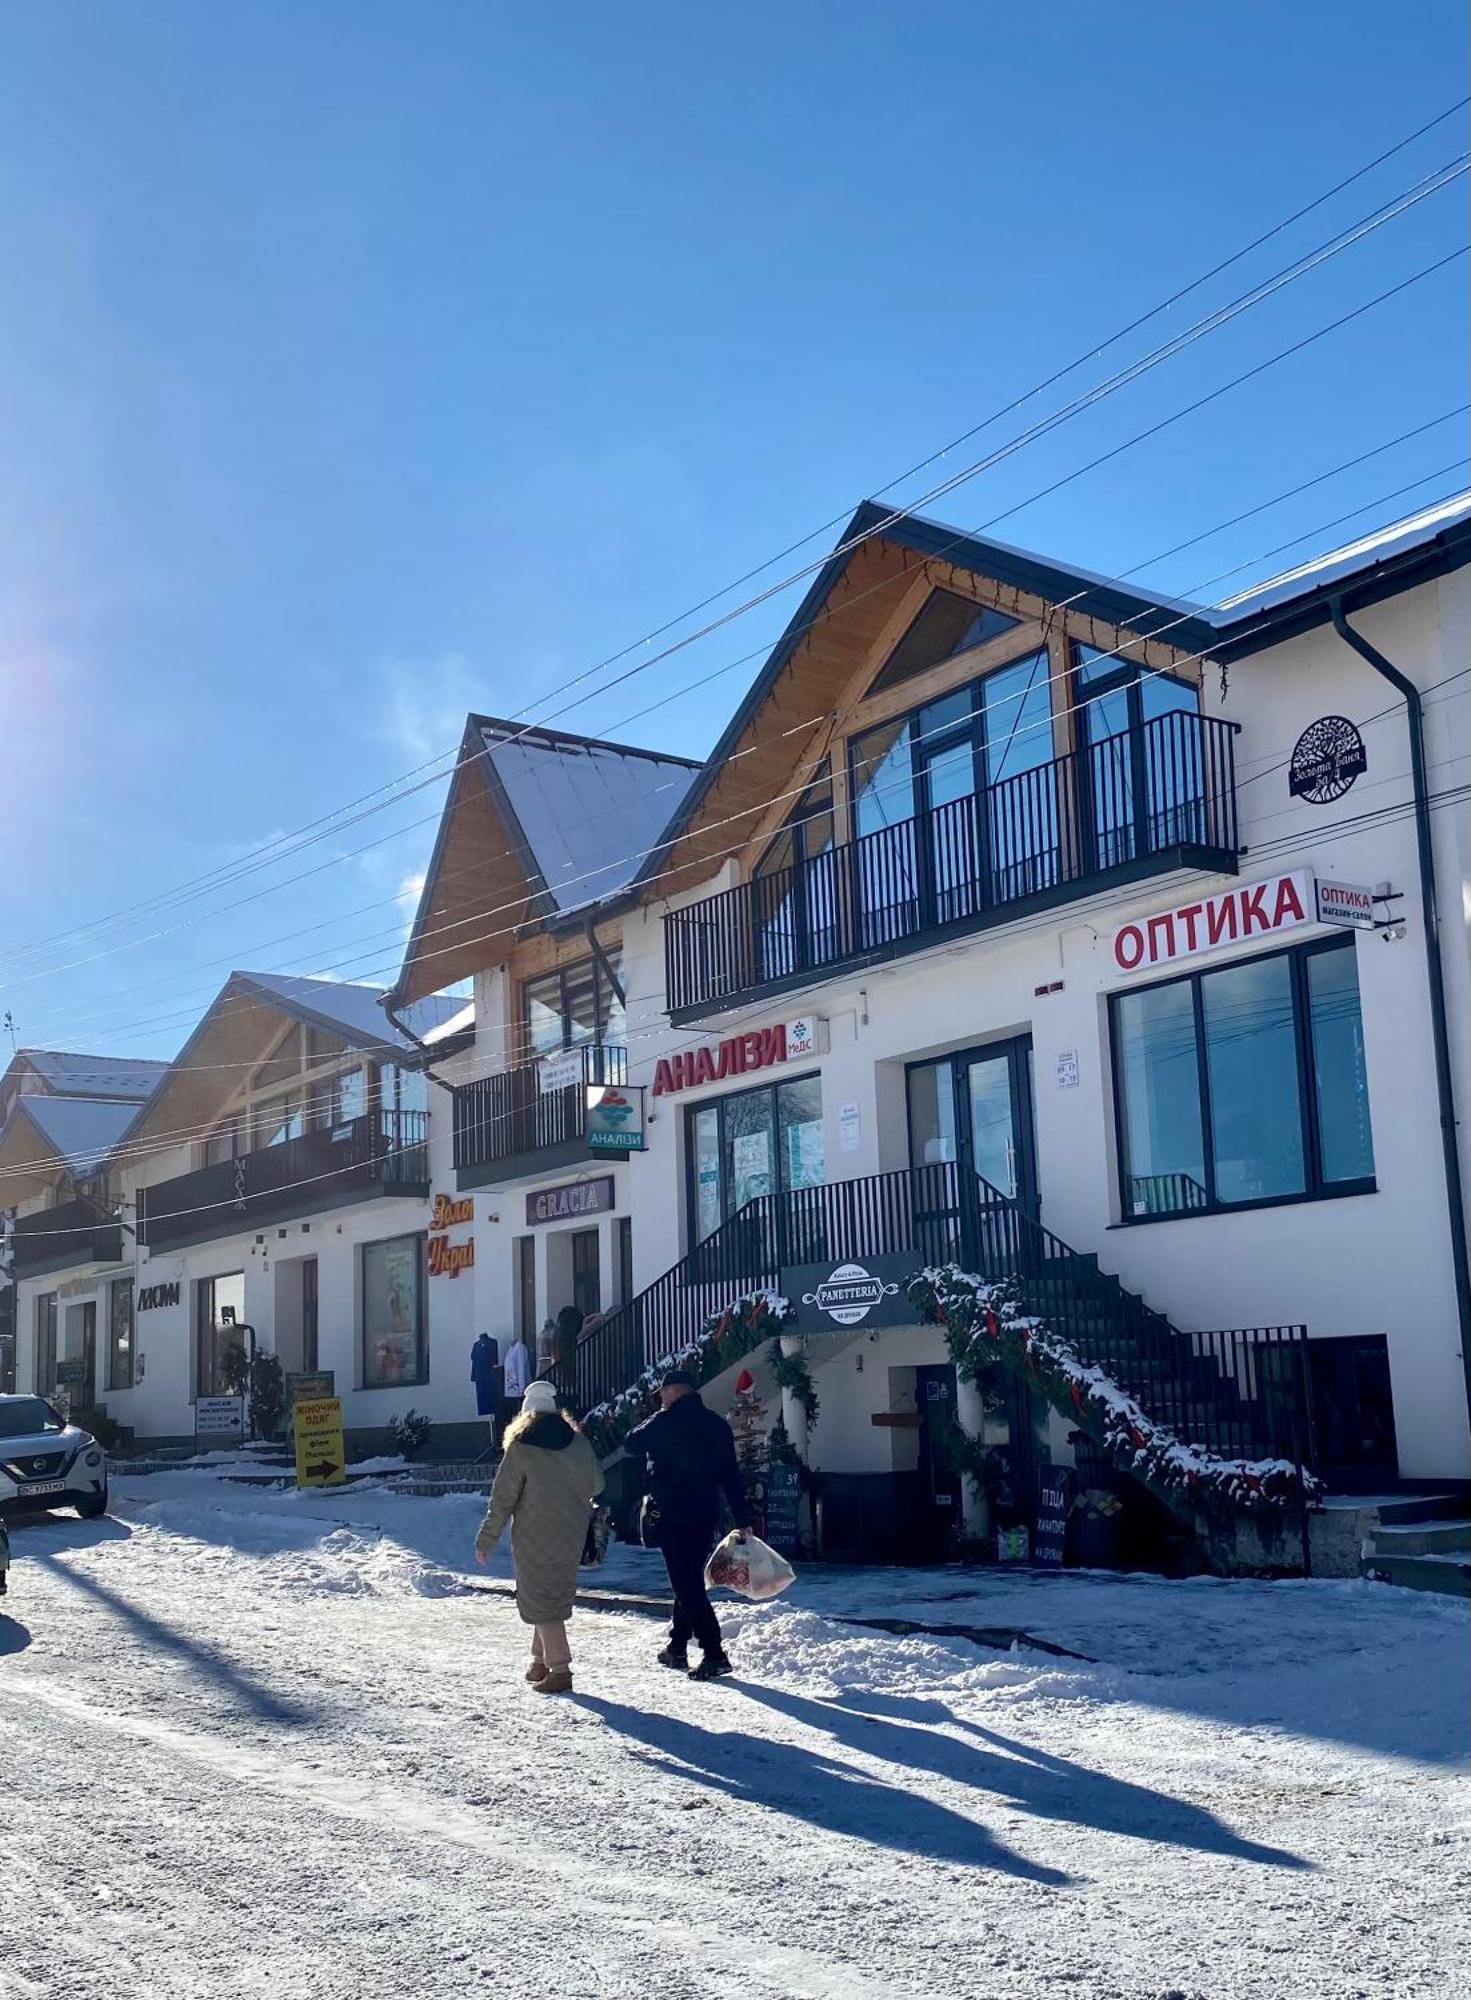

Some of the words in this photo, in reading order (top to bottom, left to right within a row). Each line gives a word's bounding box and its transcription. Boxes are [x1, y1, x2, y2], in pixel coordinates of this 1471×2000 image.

[1321, 887, 1370, 909] ОПТИКА
[1114, 876, 1305, 970] ОПТИКА
[1322, 906, 1372, 921] магазин-салон
[652, 1024, 787, 1096] АНАЛІЗИ
[591, 1132, 642, 1146] АНАЛІЗИ
[535, 1183, 599, 1219] GRACIA
[821, 1284, 877, 1302] PANETTERIA
[305, 1414, 329, 1426] ОДЯГ
[1042, 1488, 1064, 1508] ПІЦА
